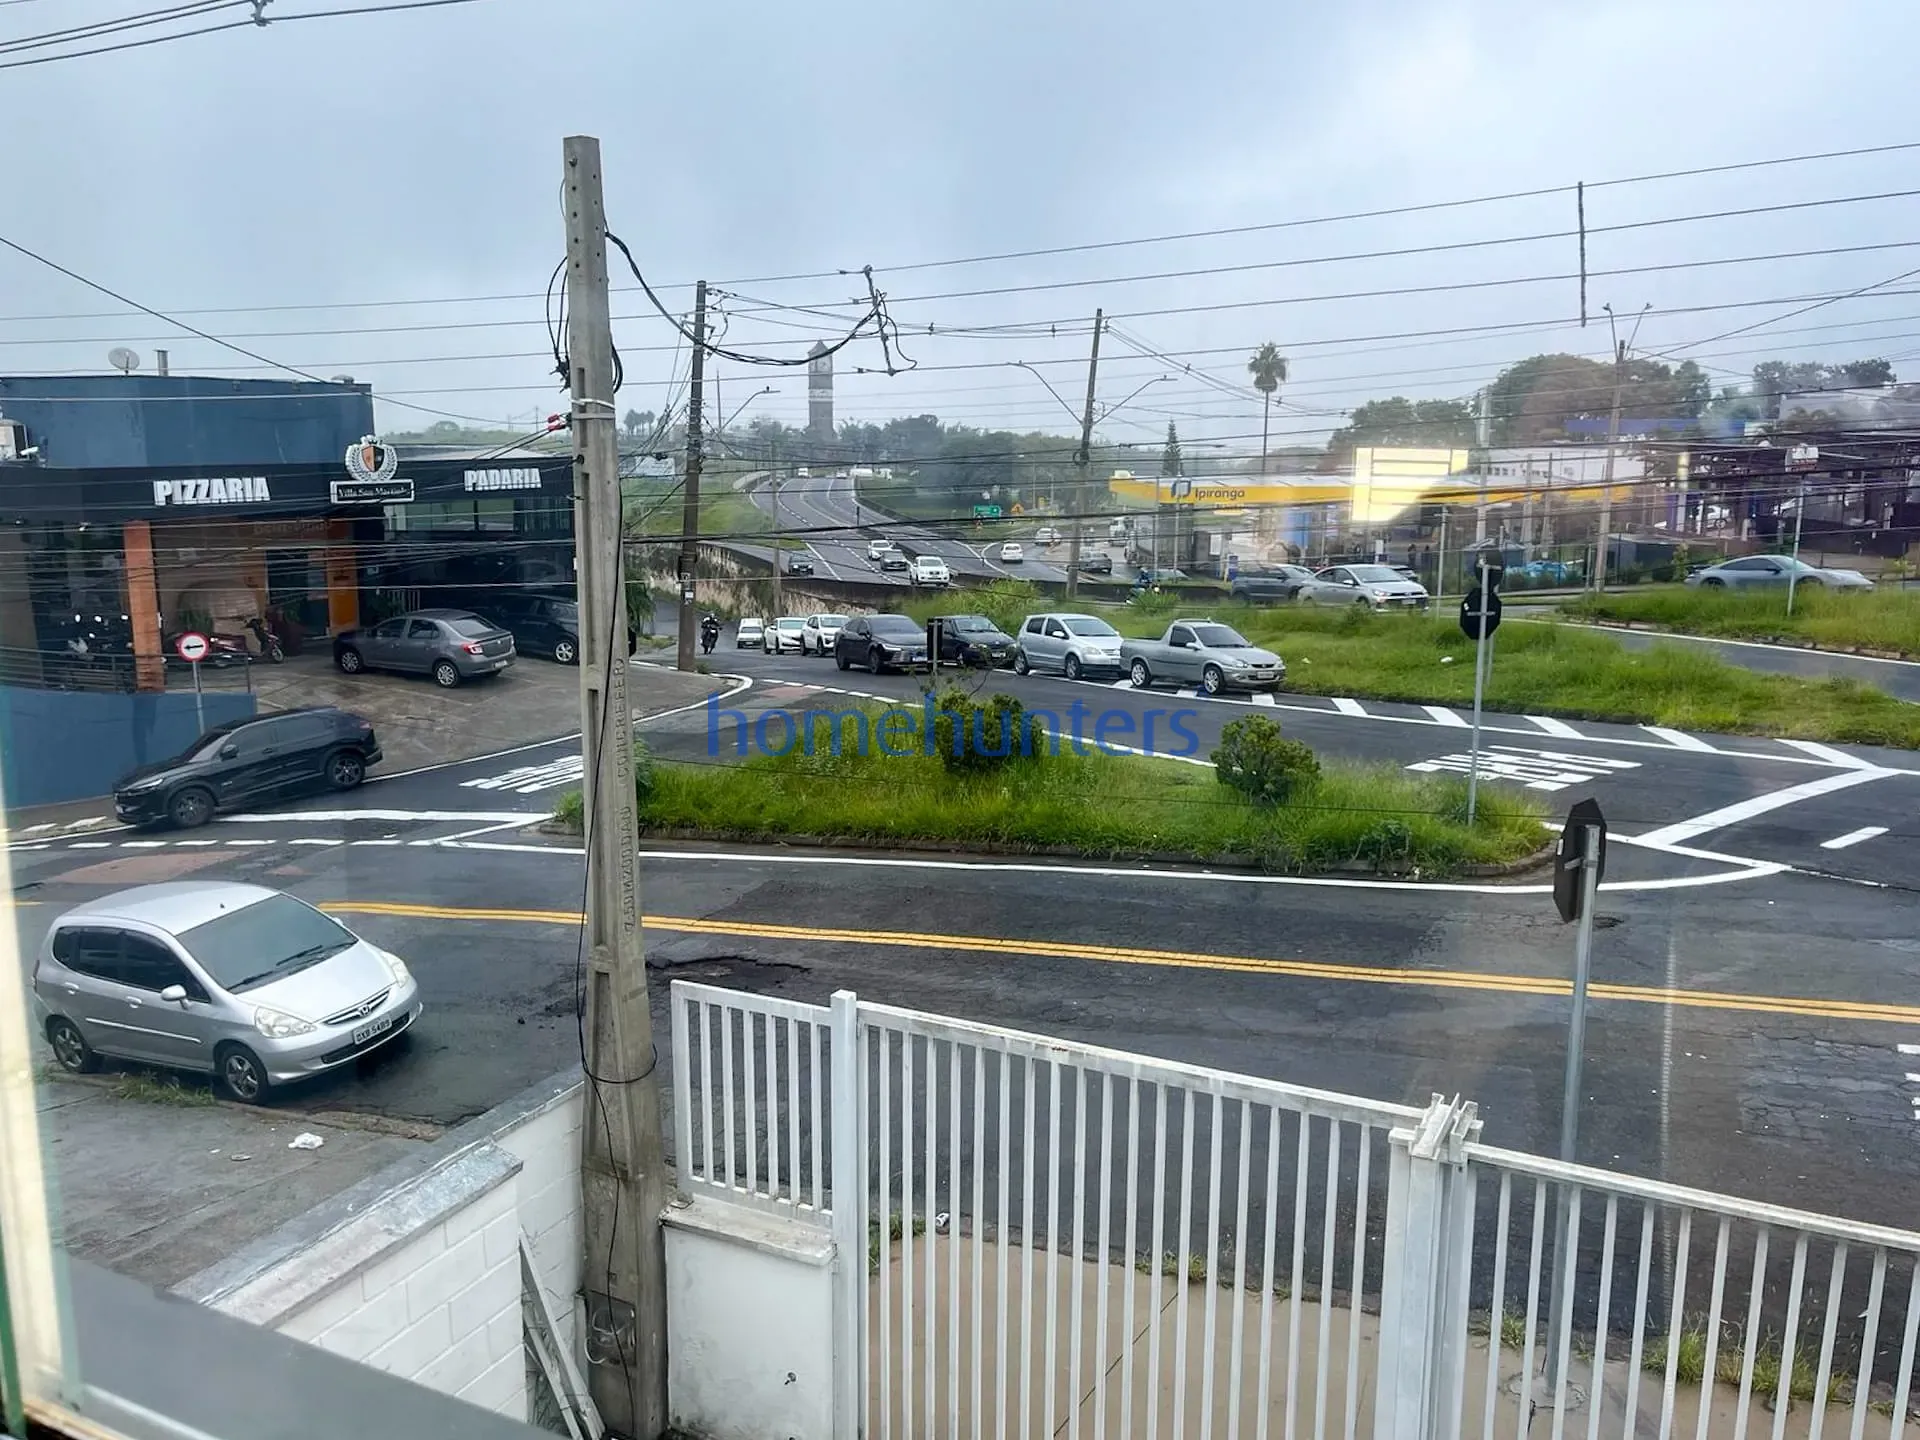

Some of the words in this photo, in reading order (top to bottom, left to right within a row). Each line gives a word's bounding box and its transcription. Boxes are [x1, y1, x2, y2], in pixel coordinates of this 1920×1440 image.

[153, 477, 270, 505] PIZZARIA
[464, 468, 541, 491] PADARIA
[1195, 488, 1245, 500] Ipiranga
